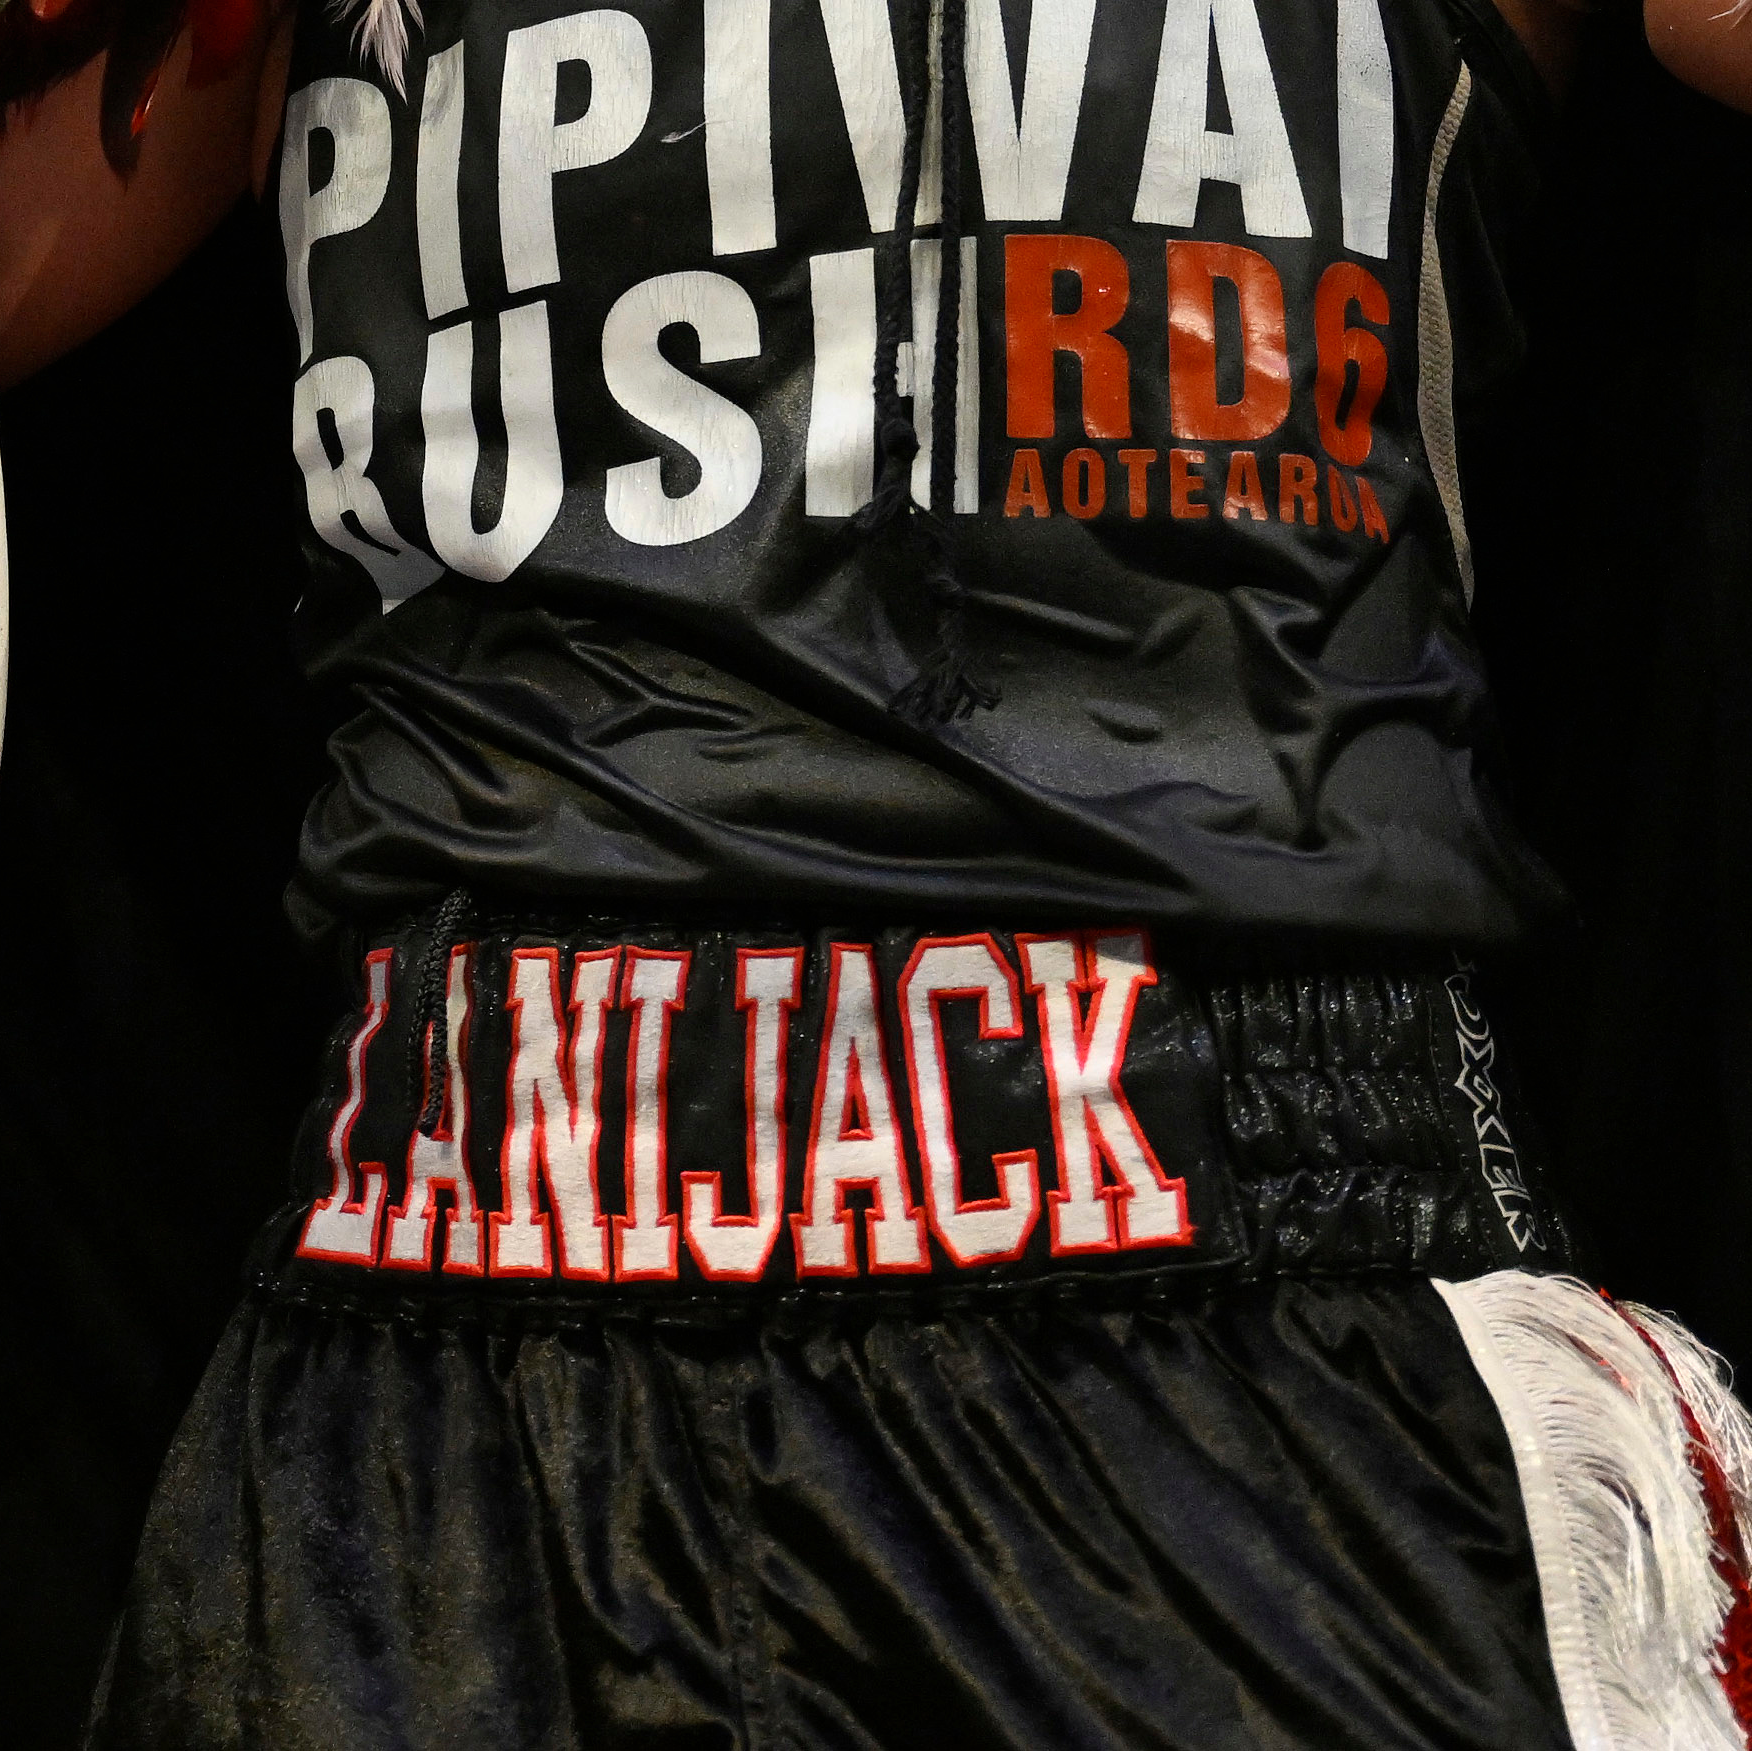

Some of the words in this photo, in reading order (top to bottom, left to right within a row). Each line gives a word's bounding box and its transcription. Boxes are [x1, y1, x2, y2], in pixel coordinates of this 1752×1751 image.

[291, 236, 980, 615] RUSH
[1003, 233, 1391, 467] RD6
[1002, 448, 1390, 545] AOTEAROA
[294, 926, 1196, 1284] LANIJACK
